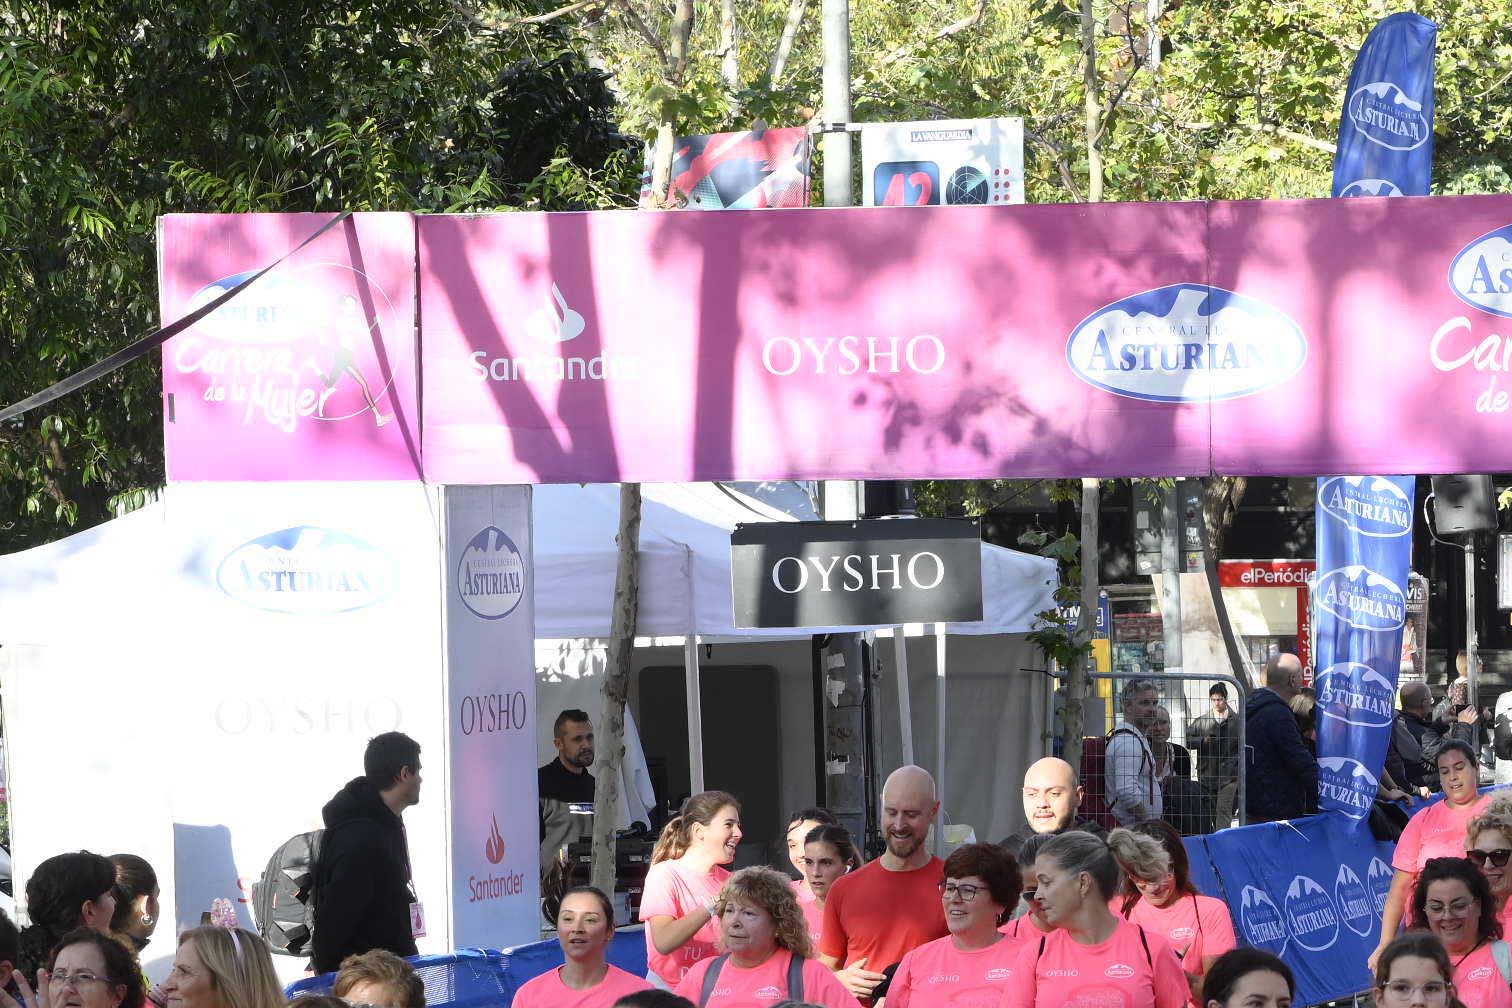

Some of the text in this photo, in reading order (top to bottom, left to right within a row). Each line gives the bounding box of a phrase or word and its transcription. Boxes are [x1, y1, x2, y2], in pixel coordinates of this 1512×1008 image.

[762, 335, 946, 376] OYSHO
[1475, 376, 1509, 413] de
[463, 562, 521, 597] ASTURIANA
[772, 551, 945, 594] OYSHO
[1241, 567, 1316, 584] elPeriódic
[460, 691, 527, 736] OYSHO
[468, 870, 525, 902] Santander
[1289, 906, 1337, 936] ASTURIANA
[1105, 967, 1133, 977] ASTURIANA
